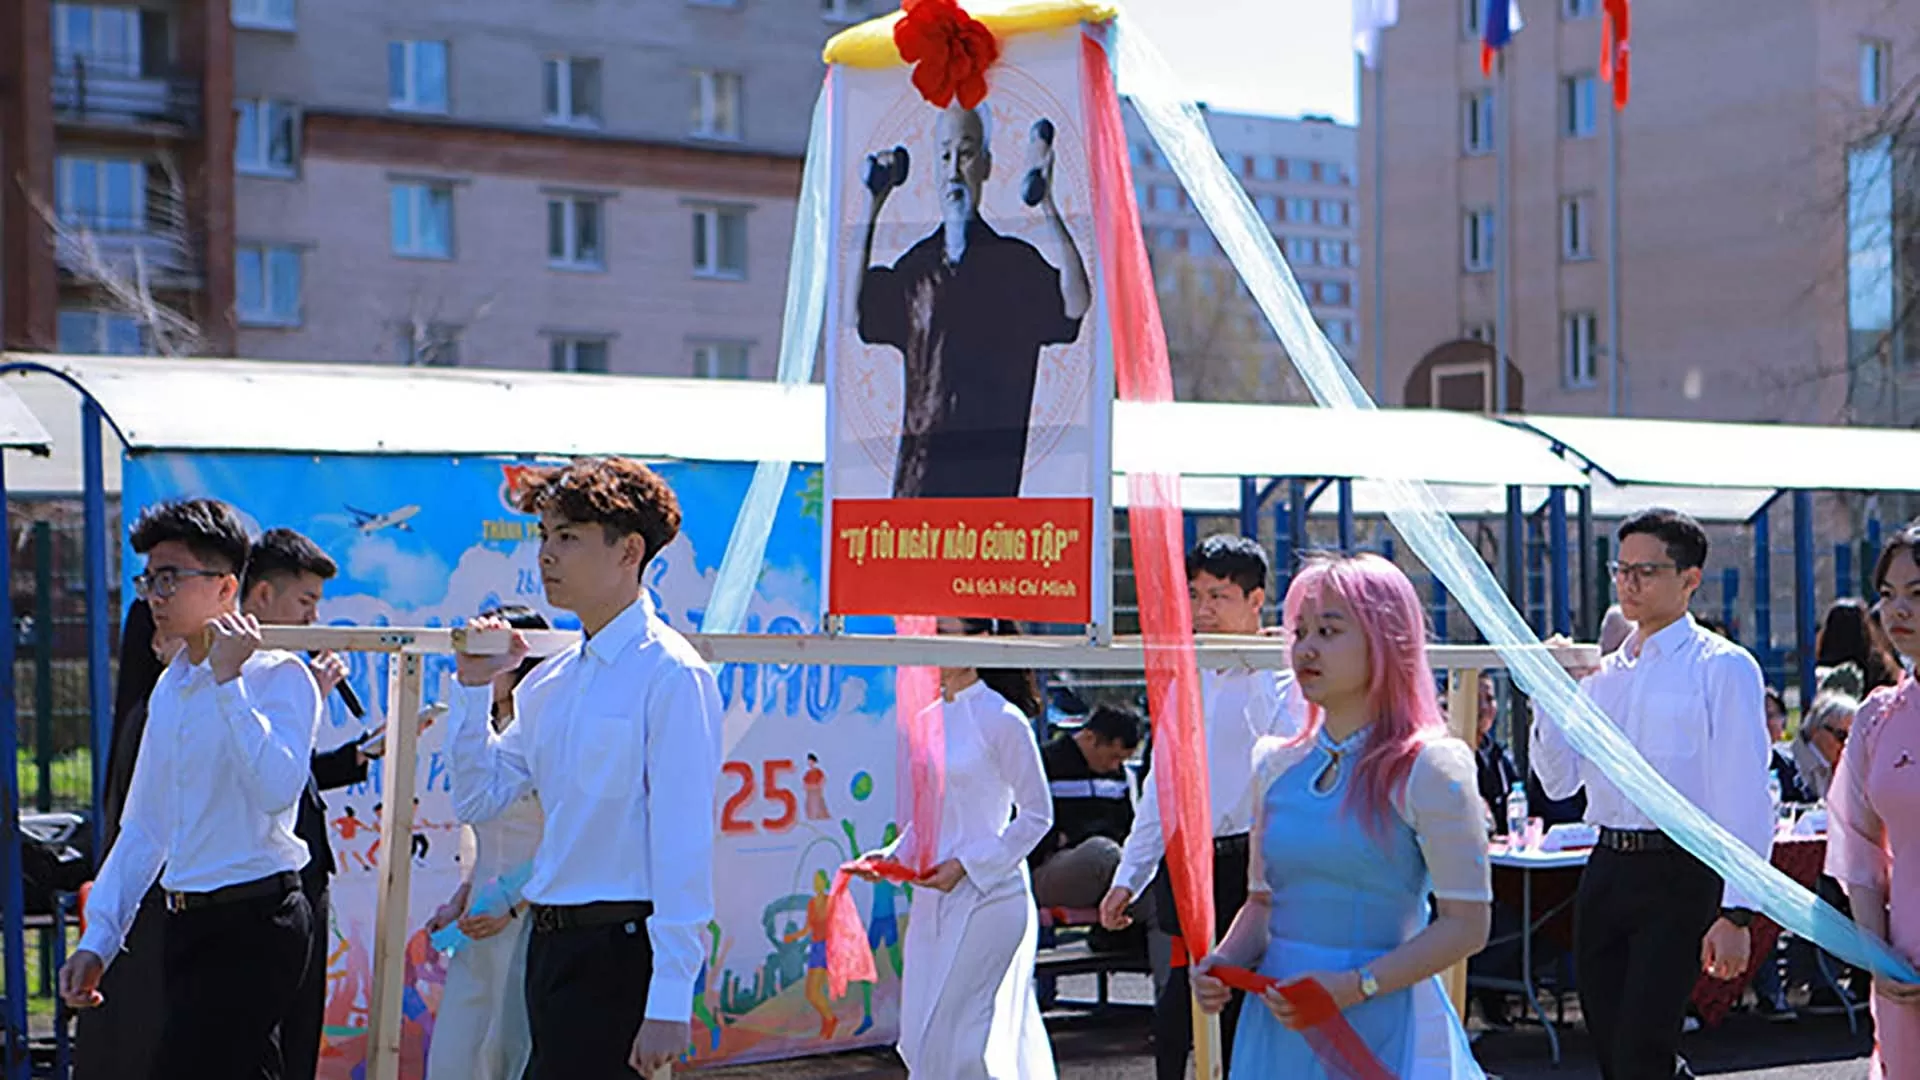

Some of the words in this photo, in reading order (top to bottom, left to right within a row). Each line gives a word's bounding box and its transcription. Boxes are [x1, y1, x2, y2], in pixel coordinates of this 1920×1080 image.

[871, 520, 895, 560] TÔI
[897, 521, 941, 560] NGÀY
[943, 520, 978, 560] NÀO
[981, 521, 1026, 561] CŨNG
